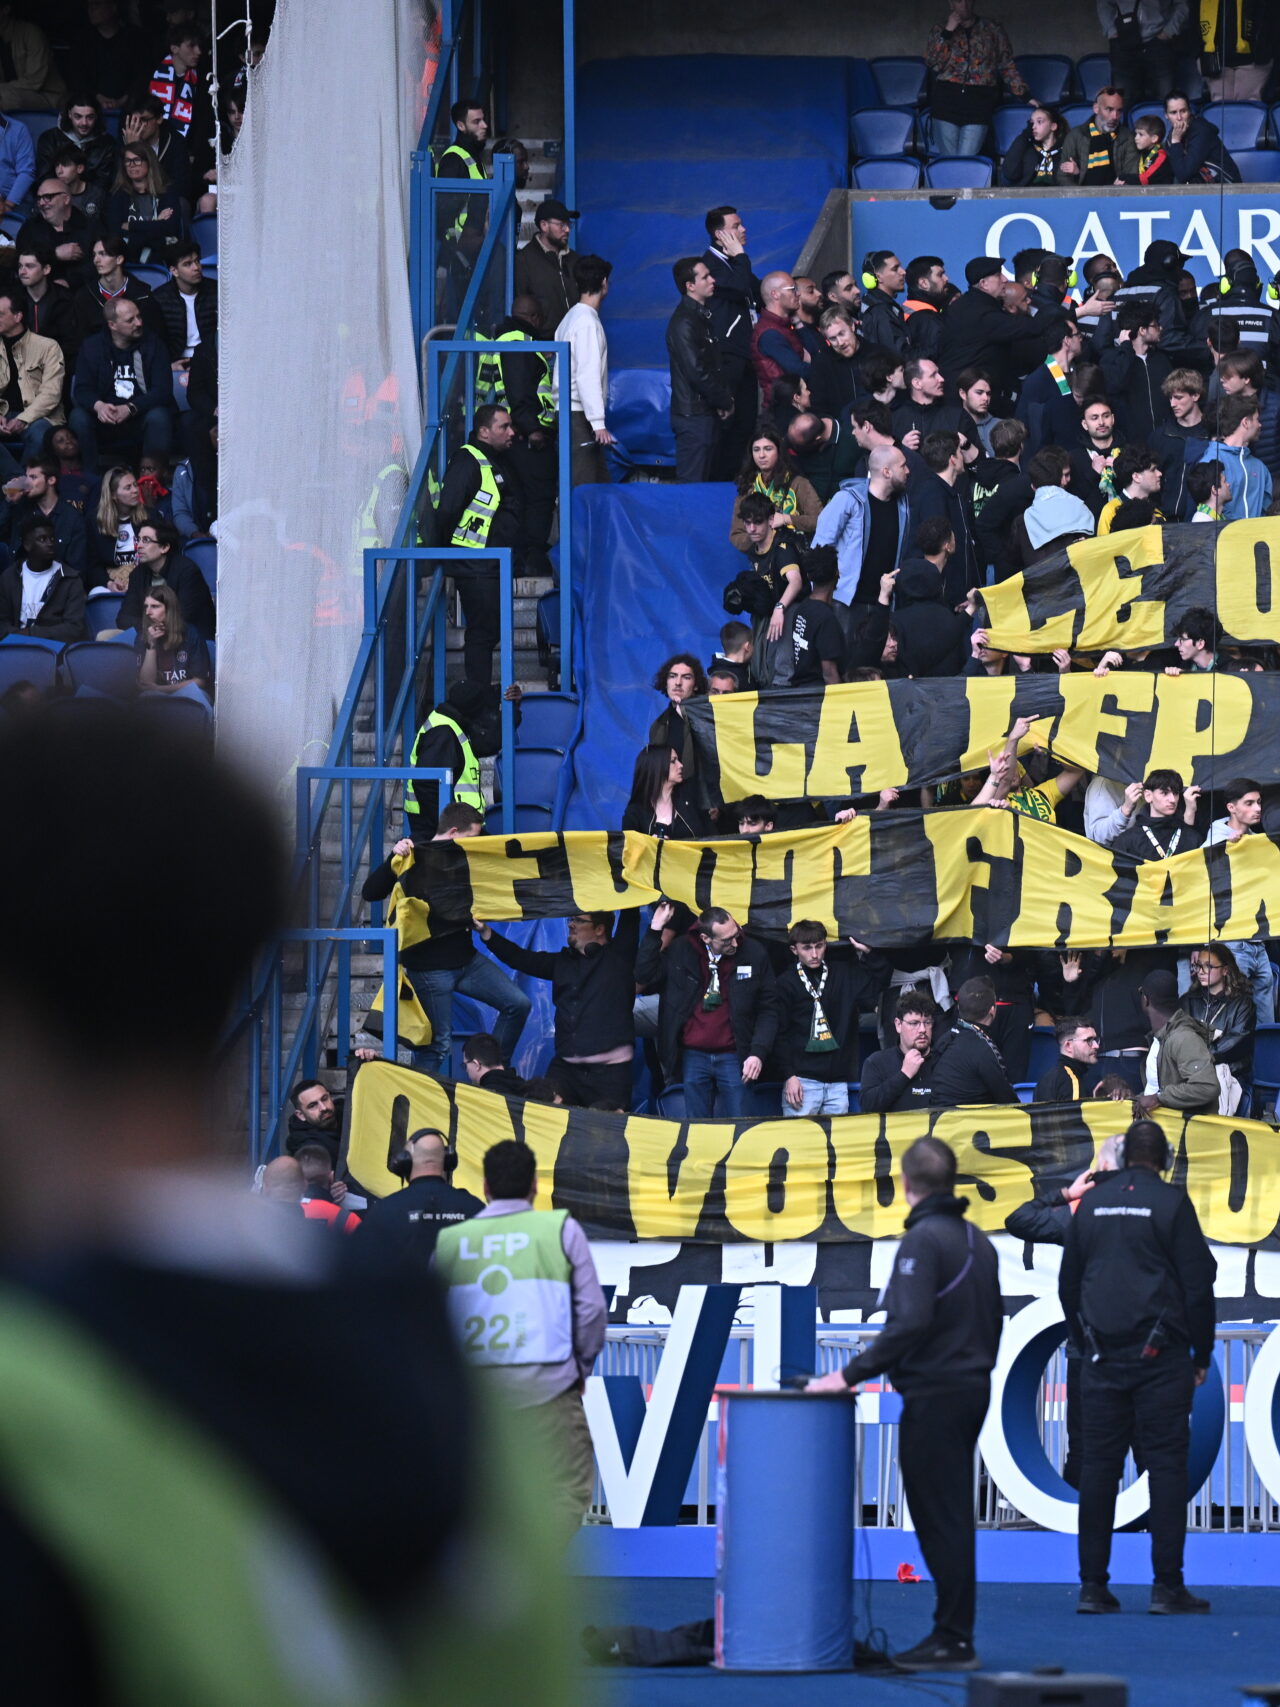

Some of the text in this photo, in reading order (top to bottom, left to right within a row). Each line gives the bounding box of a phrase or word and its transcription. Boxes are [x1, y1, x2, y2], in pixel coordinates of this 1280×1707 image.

[977, 525, 1165, 651] LE
[709, 681, 909, 803] LA
[960, 671, 1253, 788] LFP
[624, 1102, 1036, 1242] VOUS
[459, 1232, 530, 1260] LFP
[464, 1314, 510, 1351] 22
